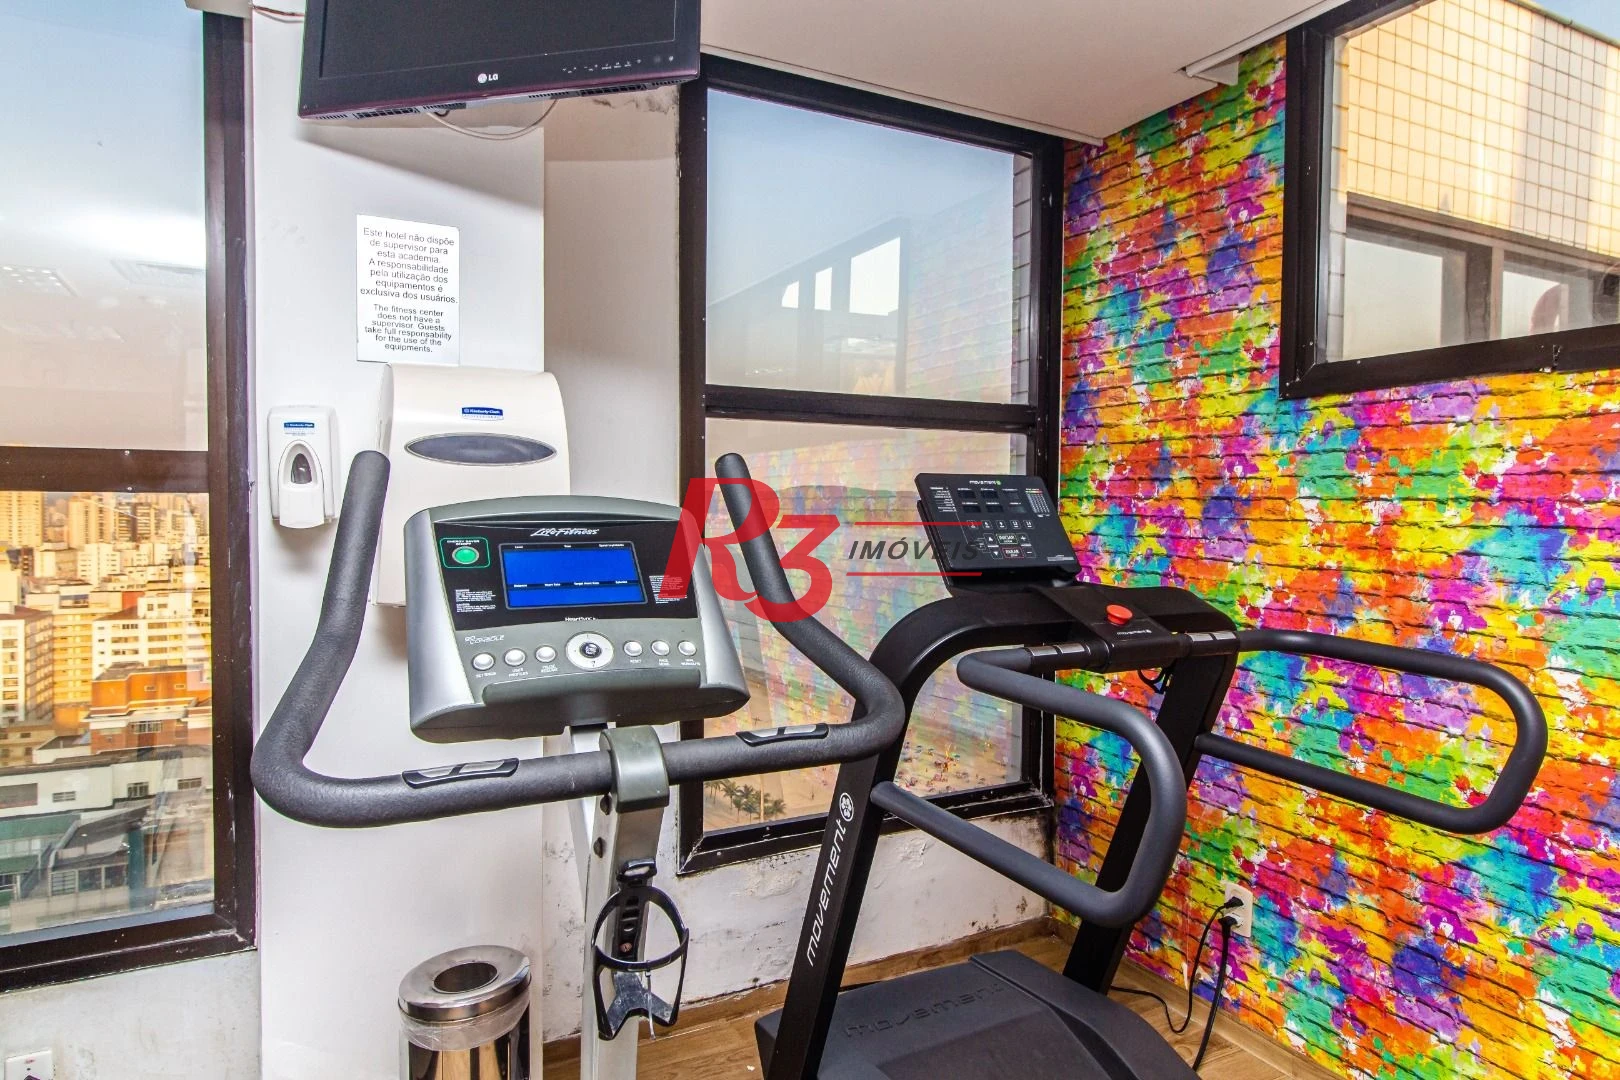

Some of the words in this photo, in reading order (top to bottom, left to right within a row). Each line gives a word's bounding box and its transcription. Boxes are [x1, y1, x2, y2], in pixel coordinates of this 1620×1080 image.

[488, 73, 499, 81] LG
[363, 227, 383, 237] Este
[385, 230, 407, 240] hotel
[408, 233, 425, 243] não
[427, 235, 455, 246] dispõe
[369, 239, 381, 247] de
[383, 241, 427, 252] supervisor
[429, 246, 448, 255] para
[377, 250, 396, 259] esta
[369, 258, 376, 266] A
[377, 260, 449, 274] responsabilidade
[370, 269, 389, 278] pela
[391, 271, 431, 282] utilização
[433, 275, 449, 284] dos
[375, 279, 436, 292] equipamentos
[437, 284, 444, 293] é
[360, 288, 400, 298] exclusiva
[402, 291, 418, 300] dos
[420, 294, 459, 304] usuários.
[373, 303, 389, 312] The
[391, 305, 417, 315] fitness
[419, 309, 444, 318] center
[414, 315, 433, 324] have
[417, 322, 446, 332] Guests
[364, 326, 382, 334] take
[384, 327, 397, 335] full
[398, 330, 452, 341] responsability
[375, 334, 387, 342] for
[388, 335, 401, 343] the
[384, 343, 433, 353] equipments.
[806, 818, 847, 968] movement
[844, 983, 1005, 1039] movement
